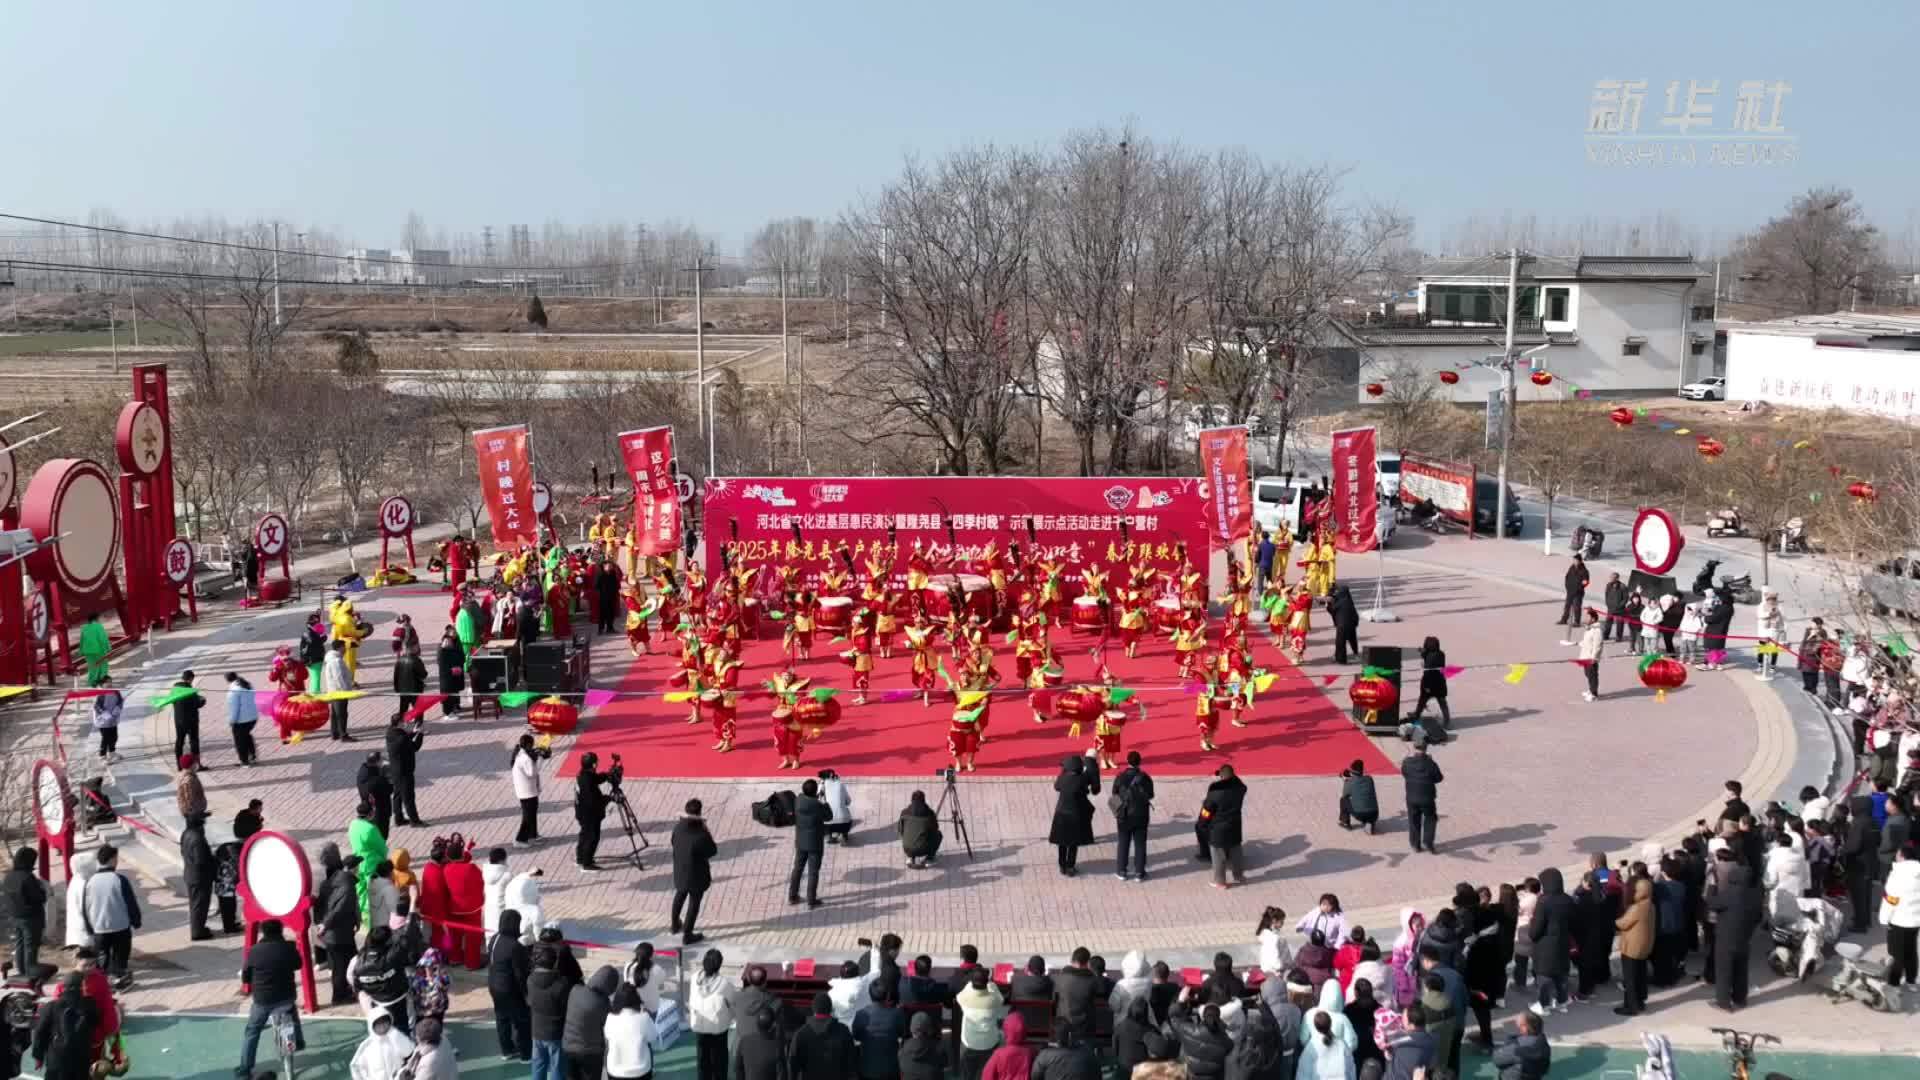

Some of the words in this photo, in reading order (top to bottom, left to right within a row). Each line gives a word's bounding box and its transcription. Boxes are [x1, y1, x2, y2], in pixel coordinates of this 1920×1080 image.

[387, 504, 405, 526] 化
[263, 523, 281, 548] 文
[168, 548, 189, 574] 鼓
